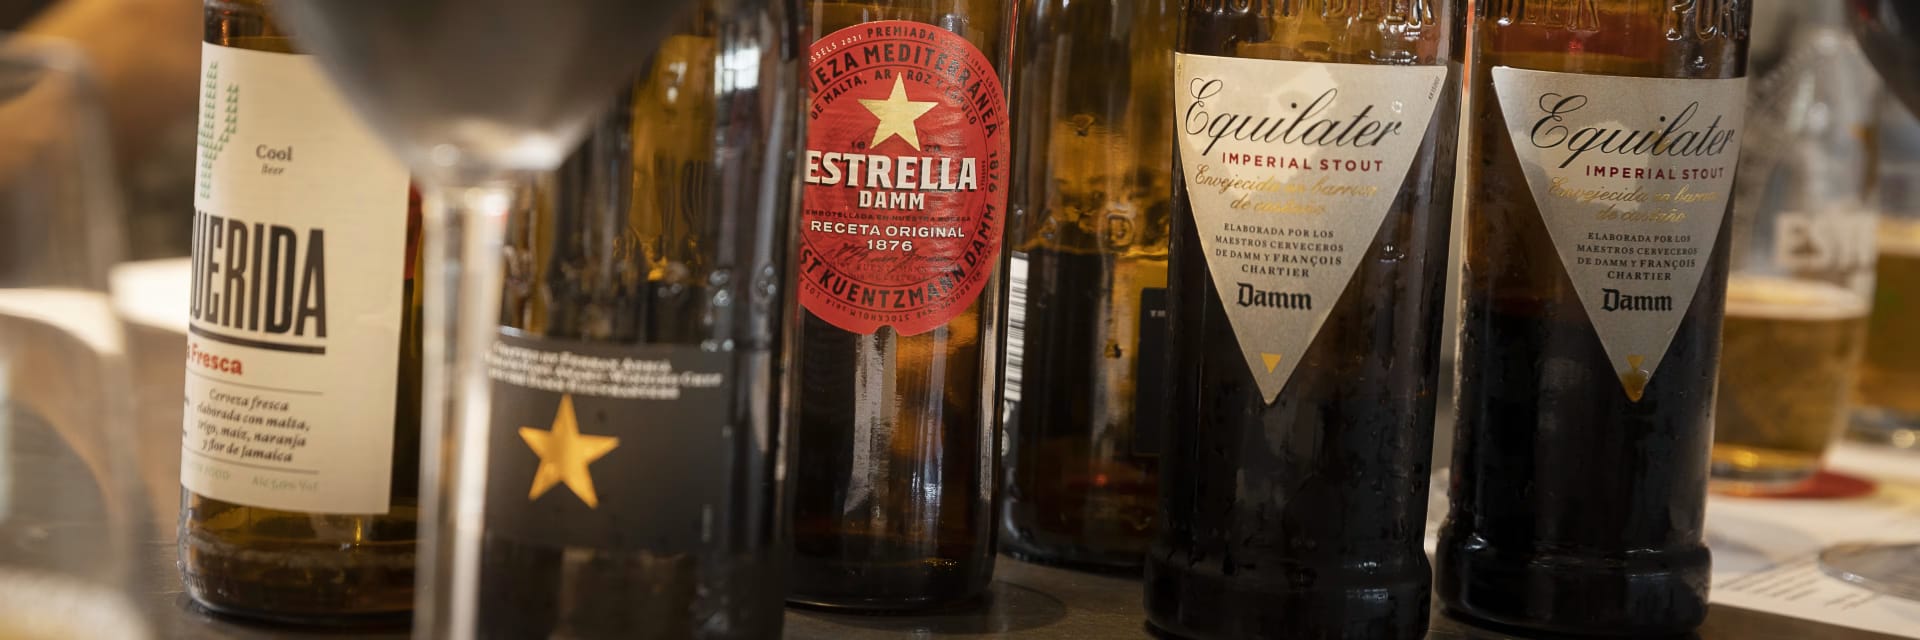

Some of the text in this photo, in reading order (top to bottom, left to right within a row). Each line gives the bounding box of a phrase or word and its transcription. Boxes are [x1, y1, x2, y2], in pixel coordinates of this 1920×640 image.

[867, 26, 935, 42] PREMIADA
[810, 104, 824, 120] DE
[1184, 77, 1403, 157] Equilater
[1530, 92, 1736, 169] Equilater
[255, 144, 293, 162] Cool
[261, 164, 284, 175] Beer
[803, 150, 978, 191] ESTRELLA
[1222, 152, 1384, 172] IMPERIAL STOUT
[1586, 165, 1724, 180] IMPERIAL STOUT
[858, 190, 925, 211] DAMM
[1230, 193, 1251, 210] de
[811, 220, 965, 238] RECETA ORIGINAL
[964, 204, 996, 267] DAMM
[1224, 222, 1334, 239] ELABORADA POR LOS
[1587, 232, 1691, 243] ELABORADA POR LOS
[866, 239, 913, 252] 1876
[1215, 235, 1344, 252] MAESTROS CERVECEROS
[1576, 244, 1698, 255] MAESTROS CERVECEROS
[1215, 248, 1343, 267] DE DAMM Y FRANÇOIS
[1594, 259, 1627, 268] DAMM
[1631, 260, 1637, 268] Y
[1640, 259, 1696, 272] FRANÇOIS
[1241, 264, 1310, 278] CHARTIER
[1607, 271, 1672, 281] CHARTIER
[1236, 282, 1313, 310] Damm
[1601, 288, 1673, 312] Damm
[192, 343, 242, 376] Fresca
[209, 388, 289, 411] Cerveza fresca
[242, 414, 263, 425] con
[266, 416, 310, 432] malta,
[208, 438, 225, 452] flor
[226, 442, 239, 454] de
[254, 433, 306, 450] naranja
